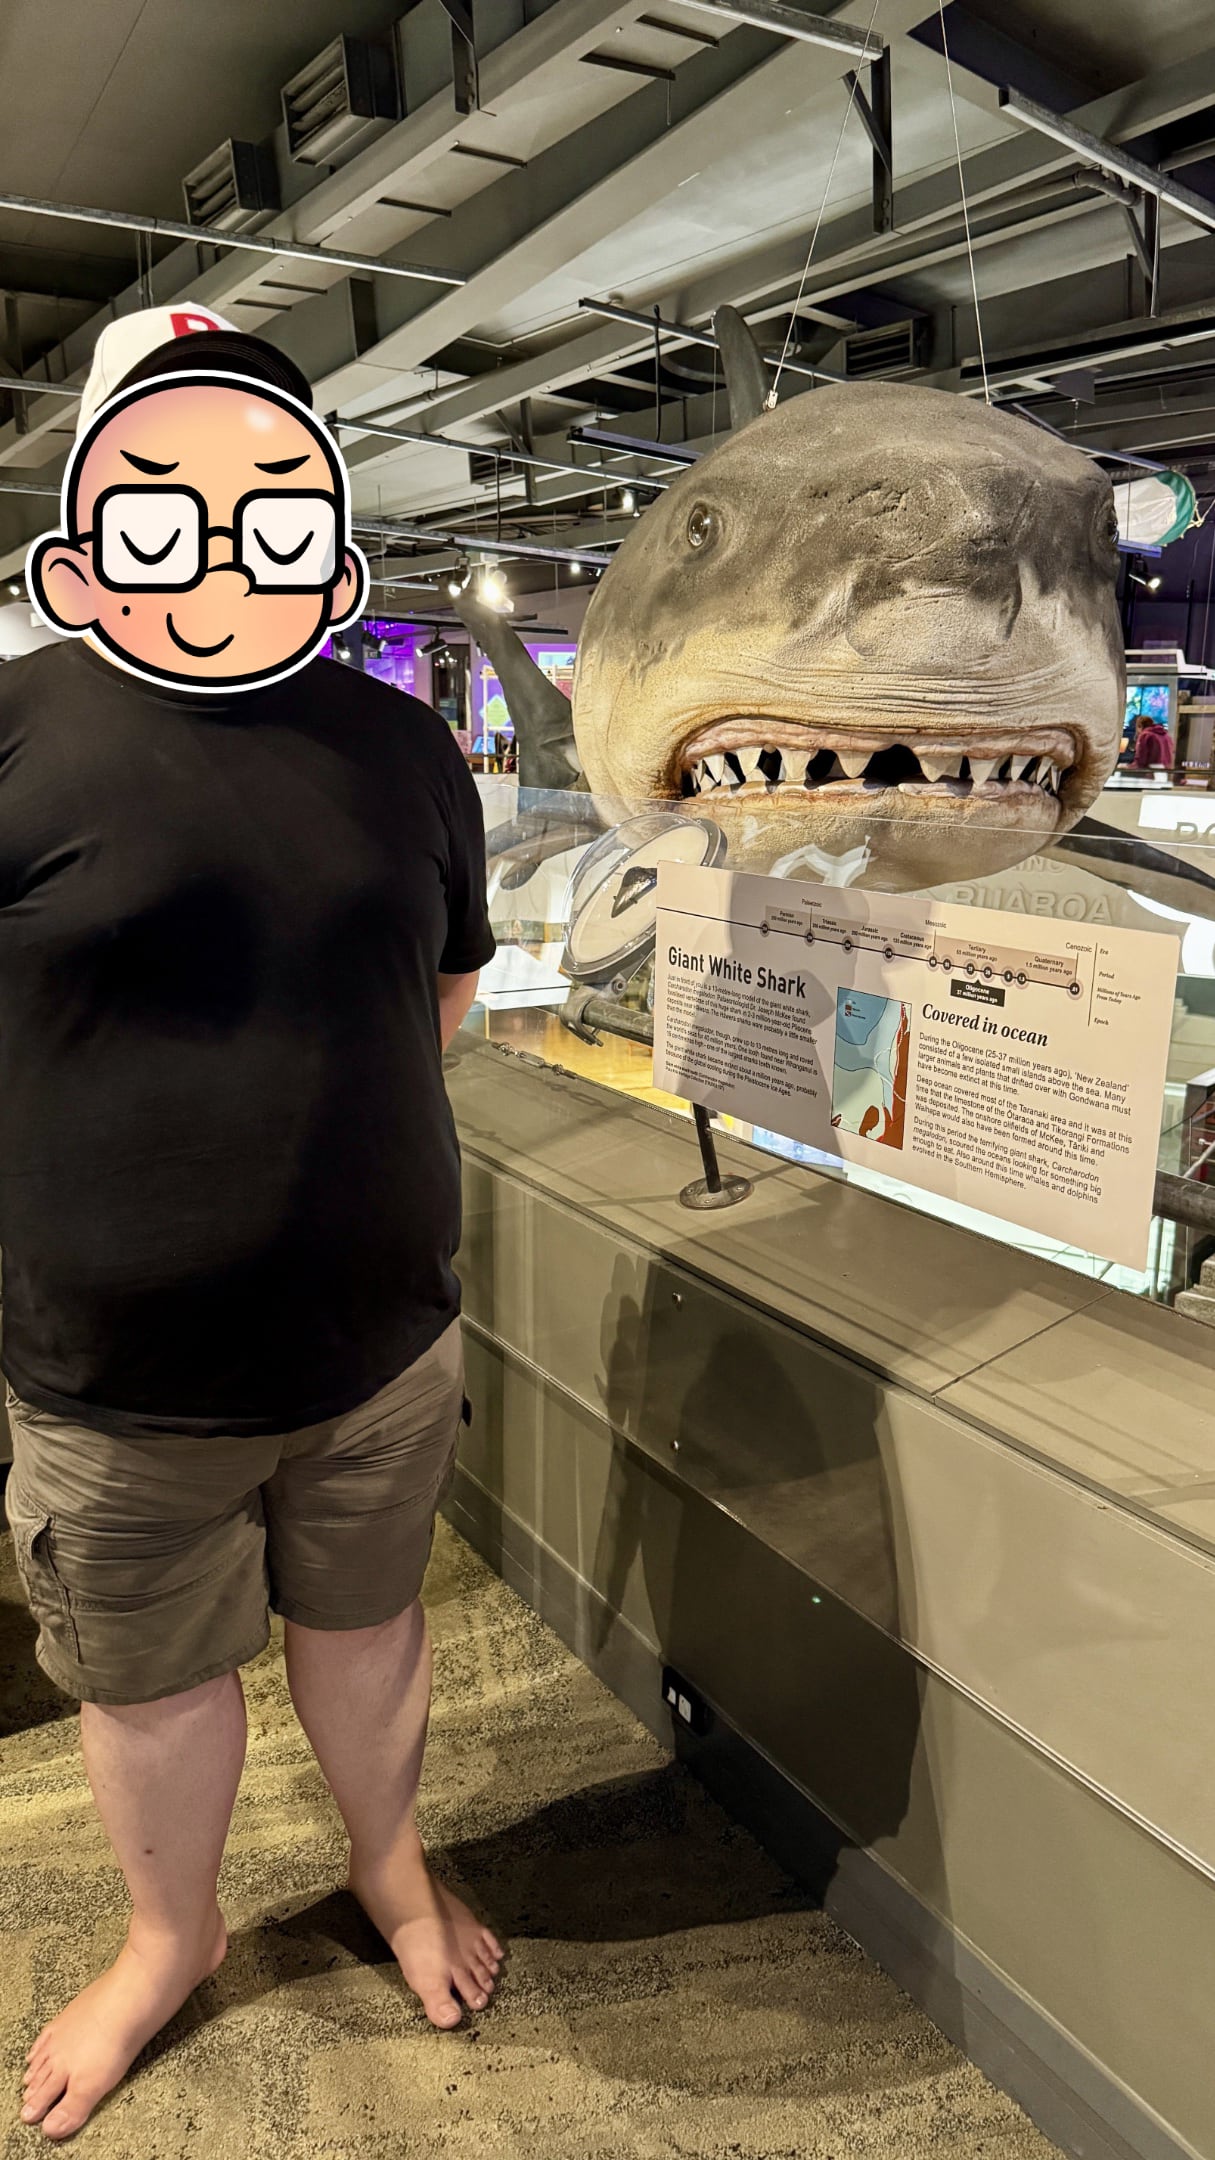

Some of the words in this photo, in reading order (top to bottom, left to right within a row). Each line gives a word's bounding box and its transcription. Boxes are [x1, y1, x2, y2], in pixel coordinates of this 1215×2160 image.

[669, 945, 705, 973] Giant
[708, 955, 752, 985] White
[757, 966, 806, 999] Shark
[968, 944, 986, 954] Tertiary
[1034, 956, 1064, 968] Quaternary
[1066, 942, 1093, 953] Cenozoic
[919, 1032, 940, 1046] During
[941, 1038, 951, 1047] the
[952, 1041, 984, 1056] Oligocene
[985, 1049, 1007, 1062] (25-37
[1009, 1056, 1030, 1068] million
[1032, 1063, 1052, 1073] years
[922, 1003, 980, 1031] Covered
[983, 1016, 998, 1036] in
[1001, 1025, 1048, 1047] ocean
[918, 1060, 932, 1071] have
[933, 1065, 957, 1078] become
[959, 1074, 980, 1085] extinct
[981, 1079, 988, 1087] at
[989, 1080, 1002, 1091] this
[918, 1051, 936, 1062] larger
[937, 1057, 961, 1069] animals
[962, 1064, 974, 1073] and
[975, 1067, 996, 1079] plants
[997, 1072, 1010, 1083] that
[1012, 1076, 1033, 1089] drifted
[1035, 1084, 1051, 1094] over
[1052, 1089, 1067, 1098] with
[1069, 1091, 1109, 1110] Gondwana
[1111, 1105, 1131, 1116] must
[919, 1043, 947, 1056] consisted
[962, 1053, 974, 1063] few
[975, 1056, 1000, 1070] isolated
[1002, 1065, 1020, 1075] small
[1022, 1069, 1045, 1082] islands
[1048, 1077, 1070, 1089] above
[1072, 1082, 1084, 1092] the
[1086, 1087, 1102, 1097] sea.
[1104, 1090, 1126, 1105] Many
[915, 1095, 927, 1103] was
[961, 1107, 974, 1118] The
[975, 1113, 1001, 1126] onshore
[1003, 1121, 1029, 1135] oilfields
[1030, 1129, 1038, 1137] of
[1040, 1131, 1066, 1148] McKee,
[1090, 1148, 1105, 1158] and
[916, 1074, 933, 1087] Deep
[934, 1081, 953, 1092] ocean
[954, 1087, 979, 1099] covered
[980, 1095, 997, 1105] most
[998, 1099, 1005, 1107] of
[1006, 1100, 1017, 1111] the
[1019, 1104, 1049, 1120] Taranaki
[1050, 1115, 1067, 1125] area
[1068, 1120, 1082, 1130] and
[1091, 1127, 1107, 1137] was
[1108, 1131, 1117, 1140] at
[1118, 1133, 1133, 1144] this
[930, 1088, 942, 1098] that
[943, 1092, 953, 1101] the
[954, 1095, 985, 1111] limestone
[994, 1107, 1005, 1117] the
[1036, 1121, 1050, 1130] and
[1051, 1124, 1085, 1142] Tikorangi
[1087, 1134, 1130, 1154] Formations
[914, 1116, 933, 1131] During
[935, 1123, 946, 1133] this
[947, 1128, 967, 1140] period
[968, 1134, 979, 1144] the
[979, 1137, 1008, 1155] terrifying
[1009, 1148, 1027, 1160] giant
[1028, 1154, 1049, 1169] shark,
[1052, 1161, 1099, 1183] Carcharodon
[941, 1112, 960, 1123] would
[961, 1118, 975, 1128] also
[976, 1121, 992, 1133] have
[993, 1127, 1011, 1139] been
[1012, 1133, 1036, 1147] formed
[1037, 1142, 1062, 1155] around
[1064, 1149, 1078, 1160] this
[1079, 1154, 1098, 1167] time.
[912, 1145, 935, 1158] evolved
[936, 1152, 942, 1160] in
[943, 1154, 953, 1164] the
[954, 1158, 983, 1174] Southern
[984, 1168, 1026, 1190] Hemisphere.
[913, 1136, 934, 1149] enough
[936, 1142, 942, 1151] to
[956, 1149, 971, 1161] Also
[972, 1156, 994, 1169] around
[995, 1162, 1008, 1173] this
[1009, 1167, 1024, 1179] time
[1026, 1174, 1050, 1188] whales
[1051, 1183, 1065, 1193] and
[1067, 1186, 1098, 1204] dolphins
[949, 1139, 974, 1152] scoured
[975, 1146, 986, 1156] the
[987, 1151, 1011, 1164] oceans
[1012, 1158, 1037, 1175] looking
[1039, 1167, 1049, 1177] for
[1050, 1172, 1088, 1192] something
[1090, 1184, 1102, 1197] big
